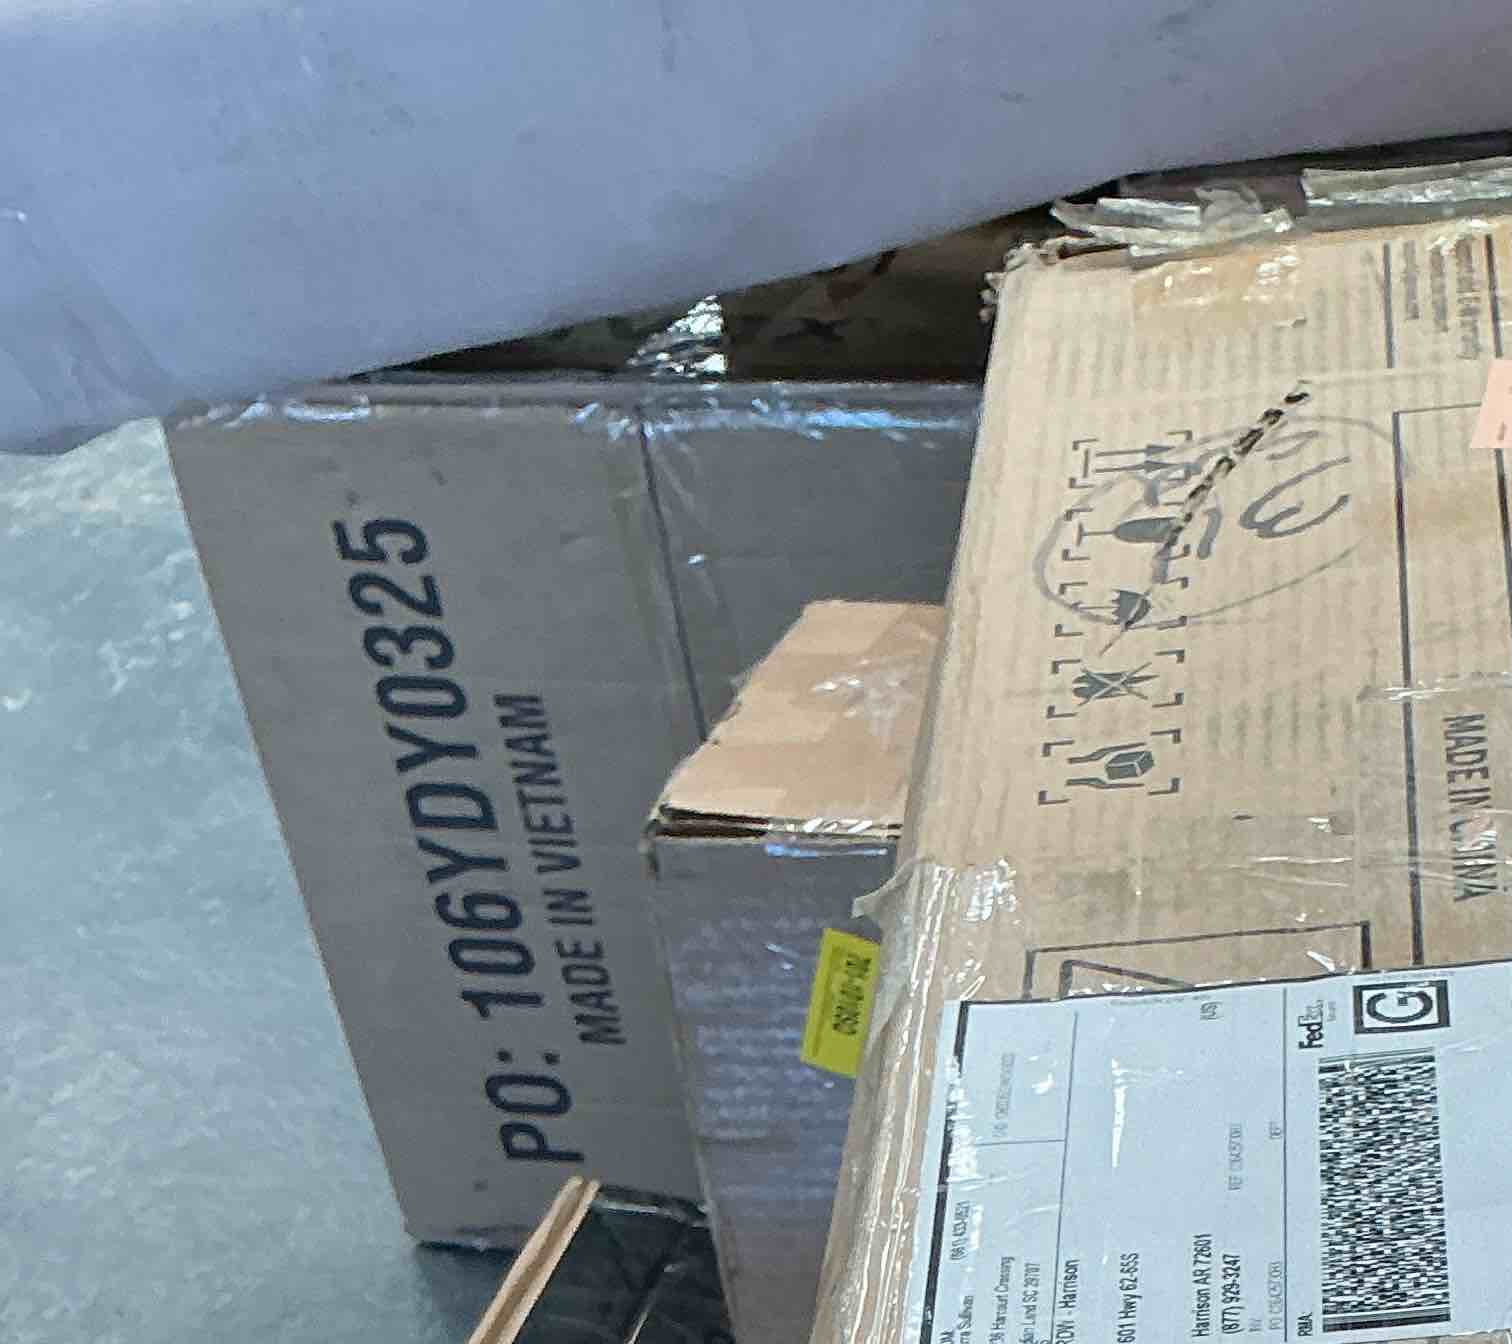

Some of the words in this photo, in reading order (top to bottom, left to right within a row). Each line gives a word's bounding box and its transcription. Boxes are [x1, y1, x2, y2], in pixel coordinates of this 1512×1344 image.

[331, 515, 546, 1022] 106YDY0325
[1443, 713, 1490, 785] MADE
[493, 691, 584, 880] VIETNAM
[1449, 787, 1492, 811] IN
[541, 884, 590, 934] IN
[552, 940, 626, 1048] MADE
[1366, 989, 1434, 1025] G
[483, 1042, 586, 1166] PO:
[1191, 1232, 1212, 1265] 72601
[1059, 1258, 1081, 1310] Harrison
[1191, 1266, 1212, 1286] AR
[1219, 1253, 1242, 1304] 929-3247
[1117, 1293, 1143, 1320] Hwy
[1191, 1288, 1212, 1338] Harrison
[1220, 1305, 1244, 1335] (877)
[1116, 1322, 1137, 1344] 601
